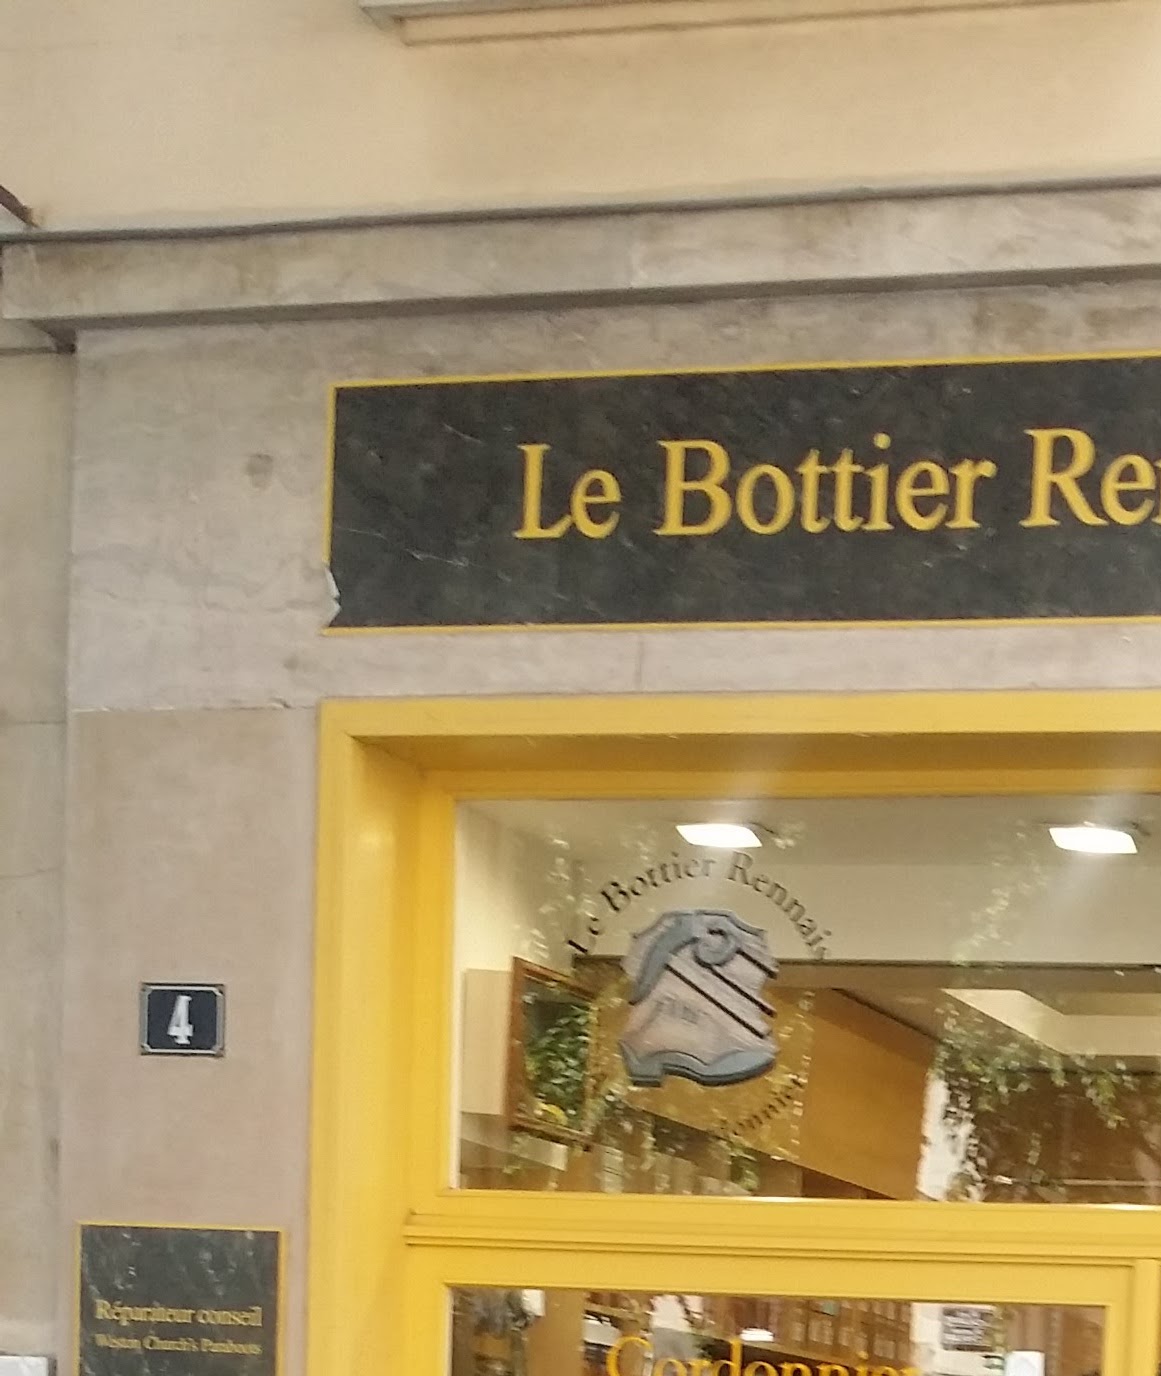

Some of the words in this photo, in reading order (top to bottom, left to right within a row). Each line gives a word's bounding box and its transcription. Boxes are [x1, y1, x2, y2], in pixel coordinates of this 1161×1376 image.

[513, 443, 622, 539] Le
[652, 432, 998, 536] Bottier
[566, 915, 604, 955] Le
[601, 852, 716, 912] Bottier
[727, 850, 832, 961] Rennais
[166, 994, 194, 1045] 4
[94, 1299, 193, 1327] Réparateur
[197, 1305, 263, 1328] conseil
